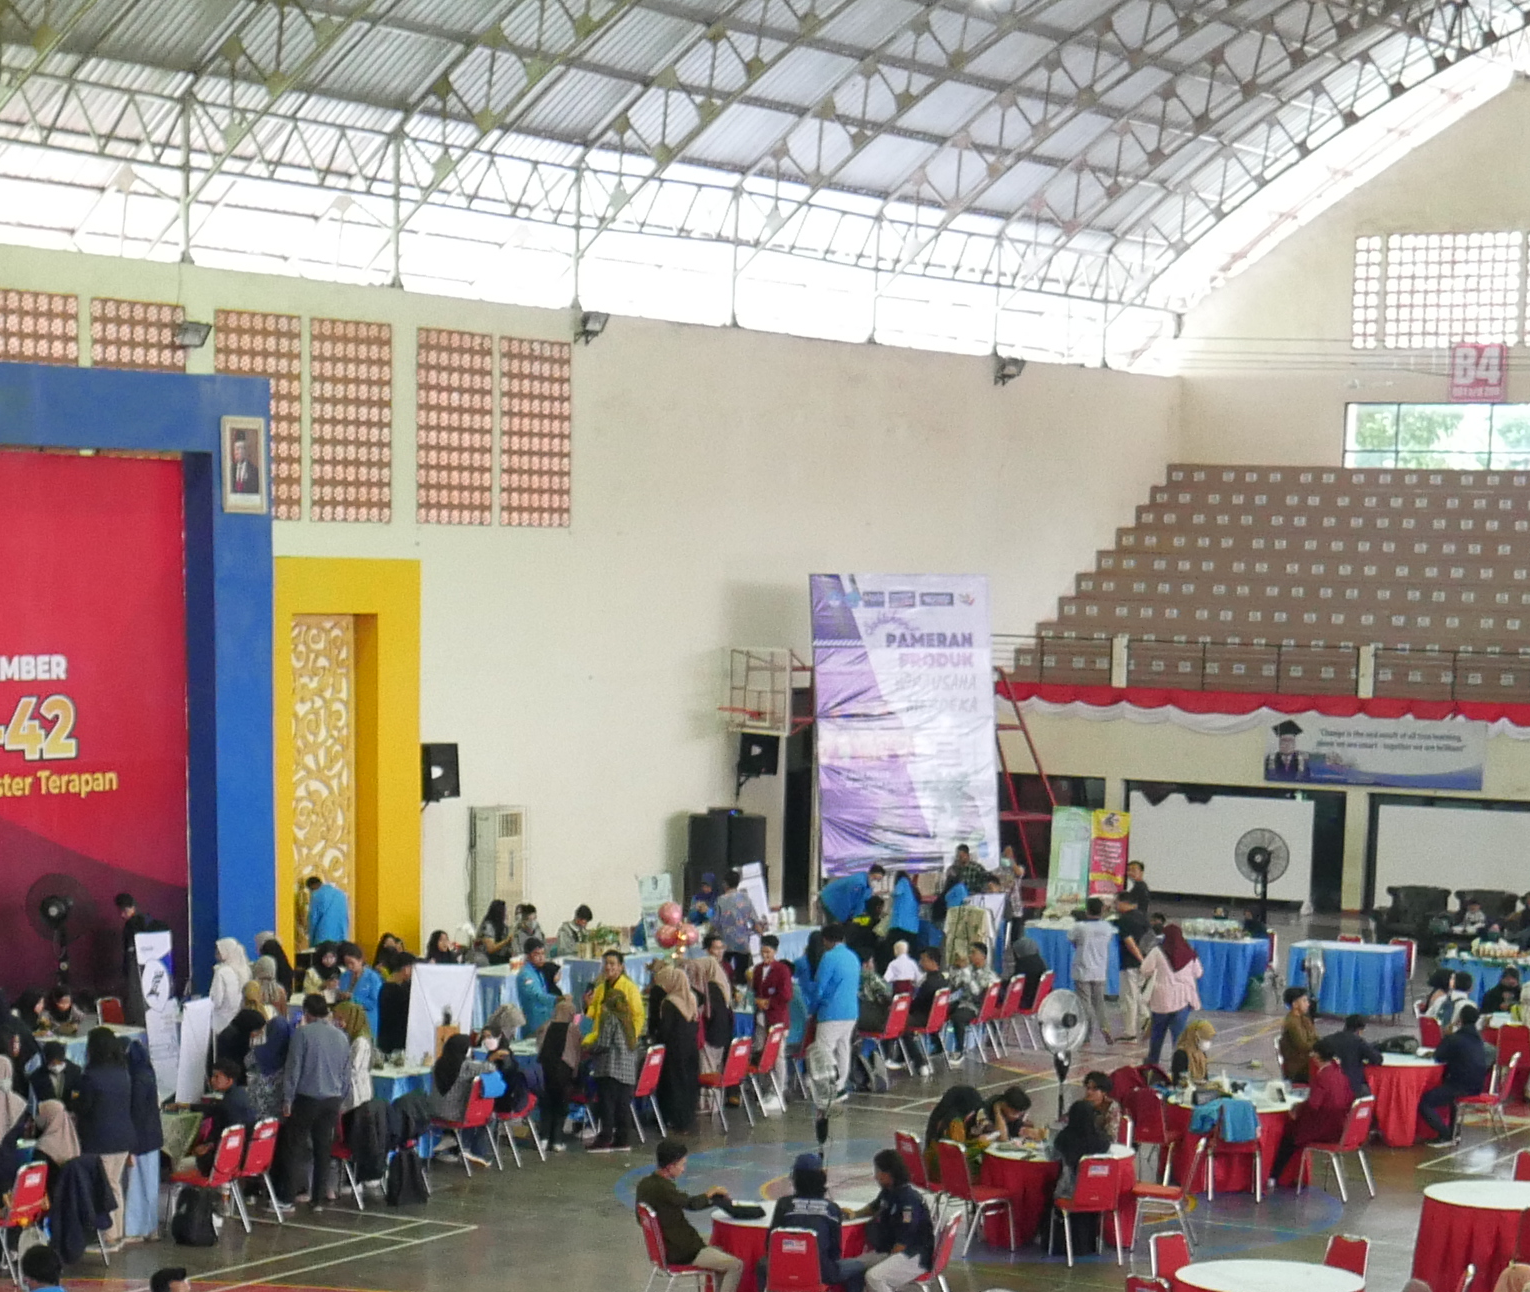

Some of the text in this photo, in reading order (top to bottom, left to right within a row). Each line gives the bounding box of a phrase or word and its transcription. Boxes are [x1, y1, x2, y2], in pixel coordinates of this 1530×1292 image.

[1453, 346, 1501, 385] B4
[885, 632, 974, 648] PAMERAN
[898, 652, 974, 668] PRODUK
[37, 770, 118, 798] Terapan
